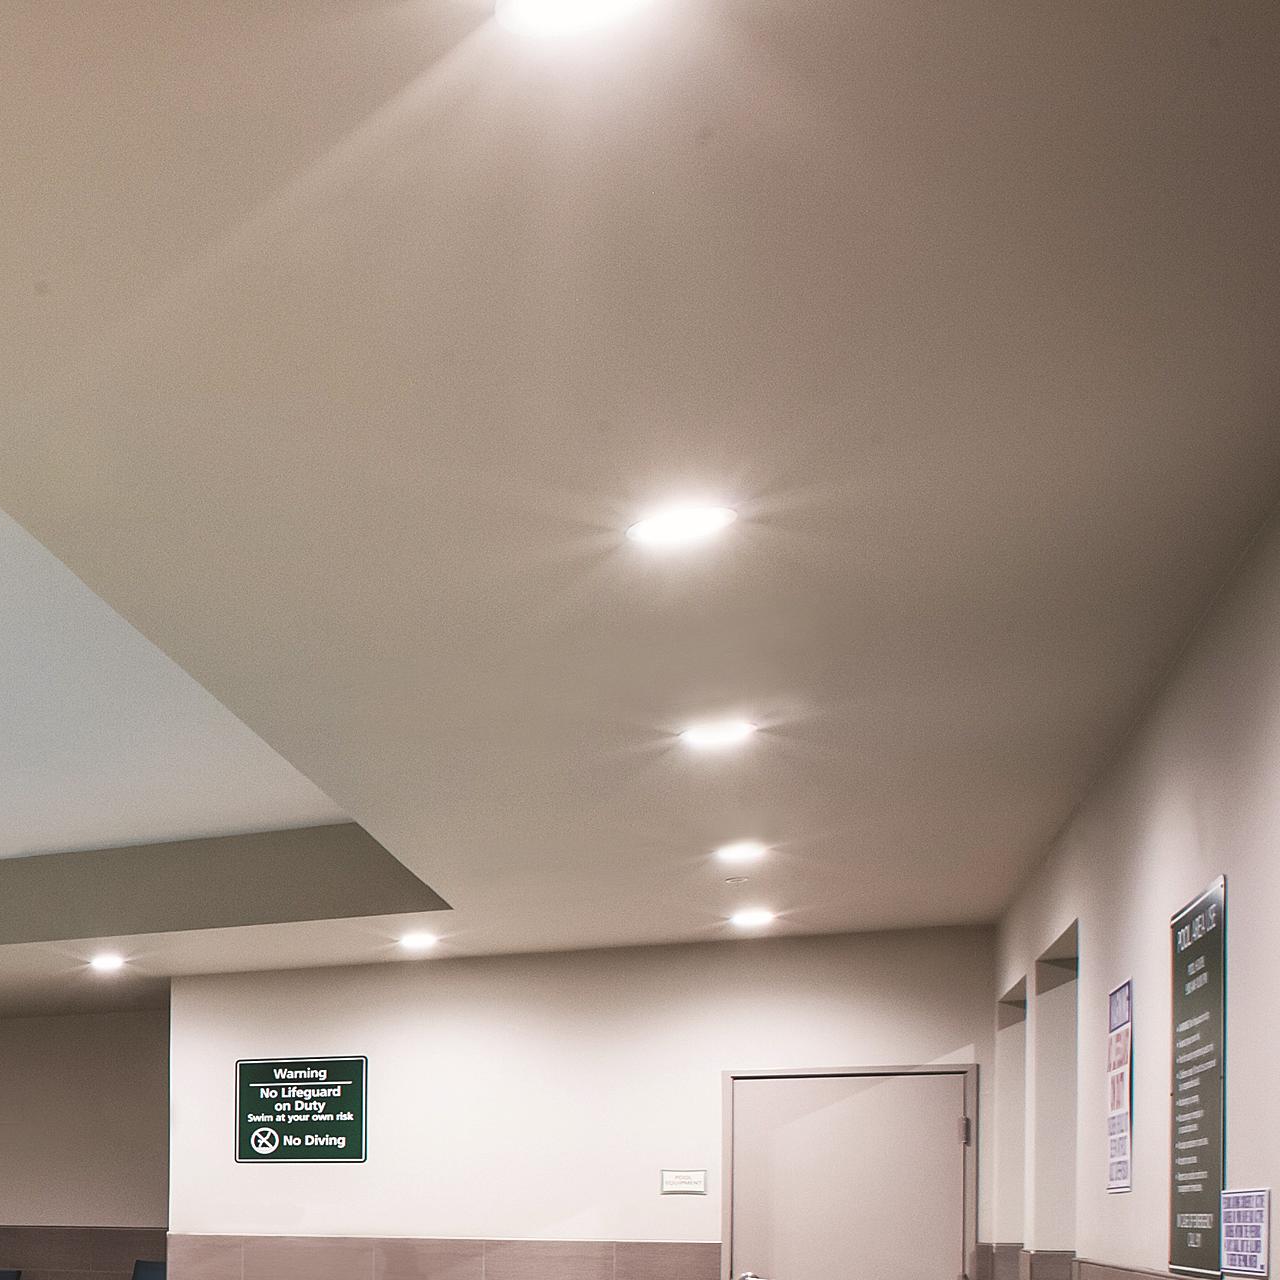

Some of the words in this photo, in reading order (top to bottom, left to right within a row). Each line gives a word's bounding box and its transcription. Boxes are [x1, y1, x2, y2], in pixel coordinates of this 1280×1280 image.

[273, 1067, 328, 1081] Warning
[260, 1088, 278, 1099] No
[281, 1086, 341, 1100] Lifeguard
[274, 1102, 291, 1111] on
[294, 1100, 326, 1113] Duty
[247, 1113, 273, 1122] Swim
[275, 1113, 285, 1122] at
[287, 1114, 310, 1123] your
[312, 1113, 334, 1121] own
[336, 1112, 354, 1121] risk
[283, 1135, 301, 1146] No
[304, 1134, 346, 1148] Diving
